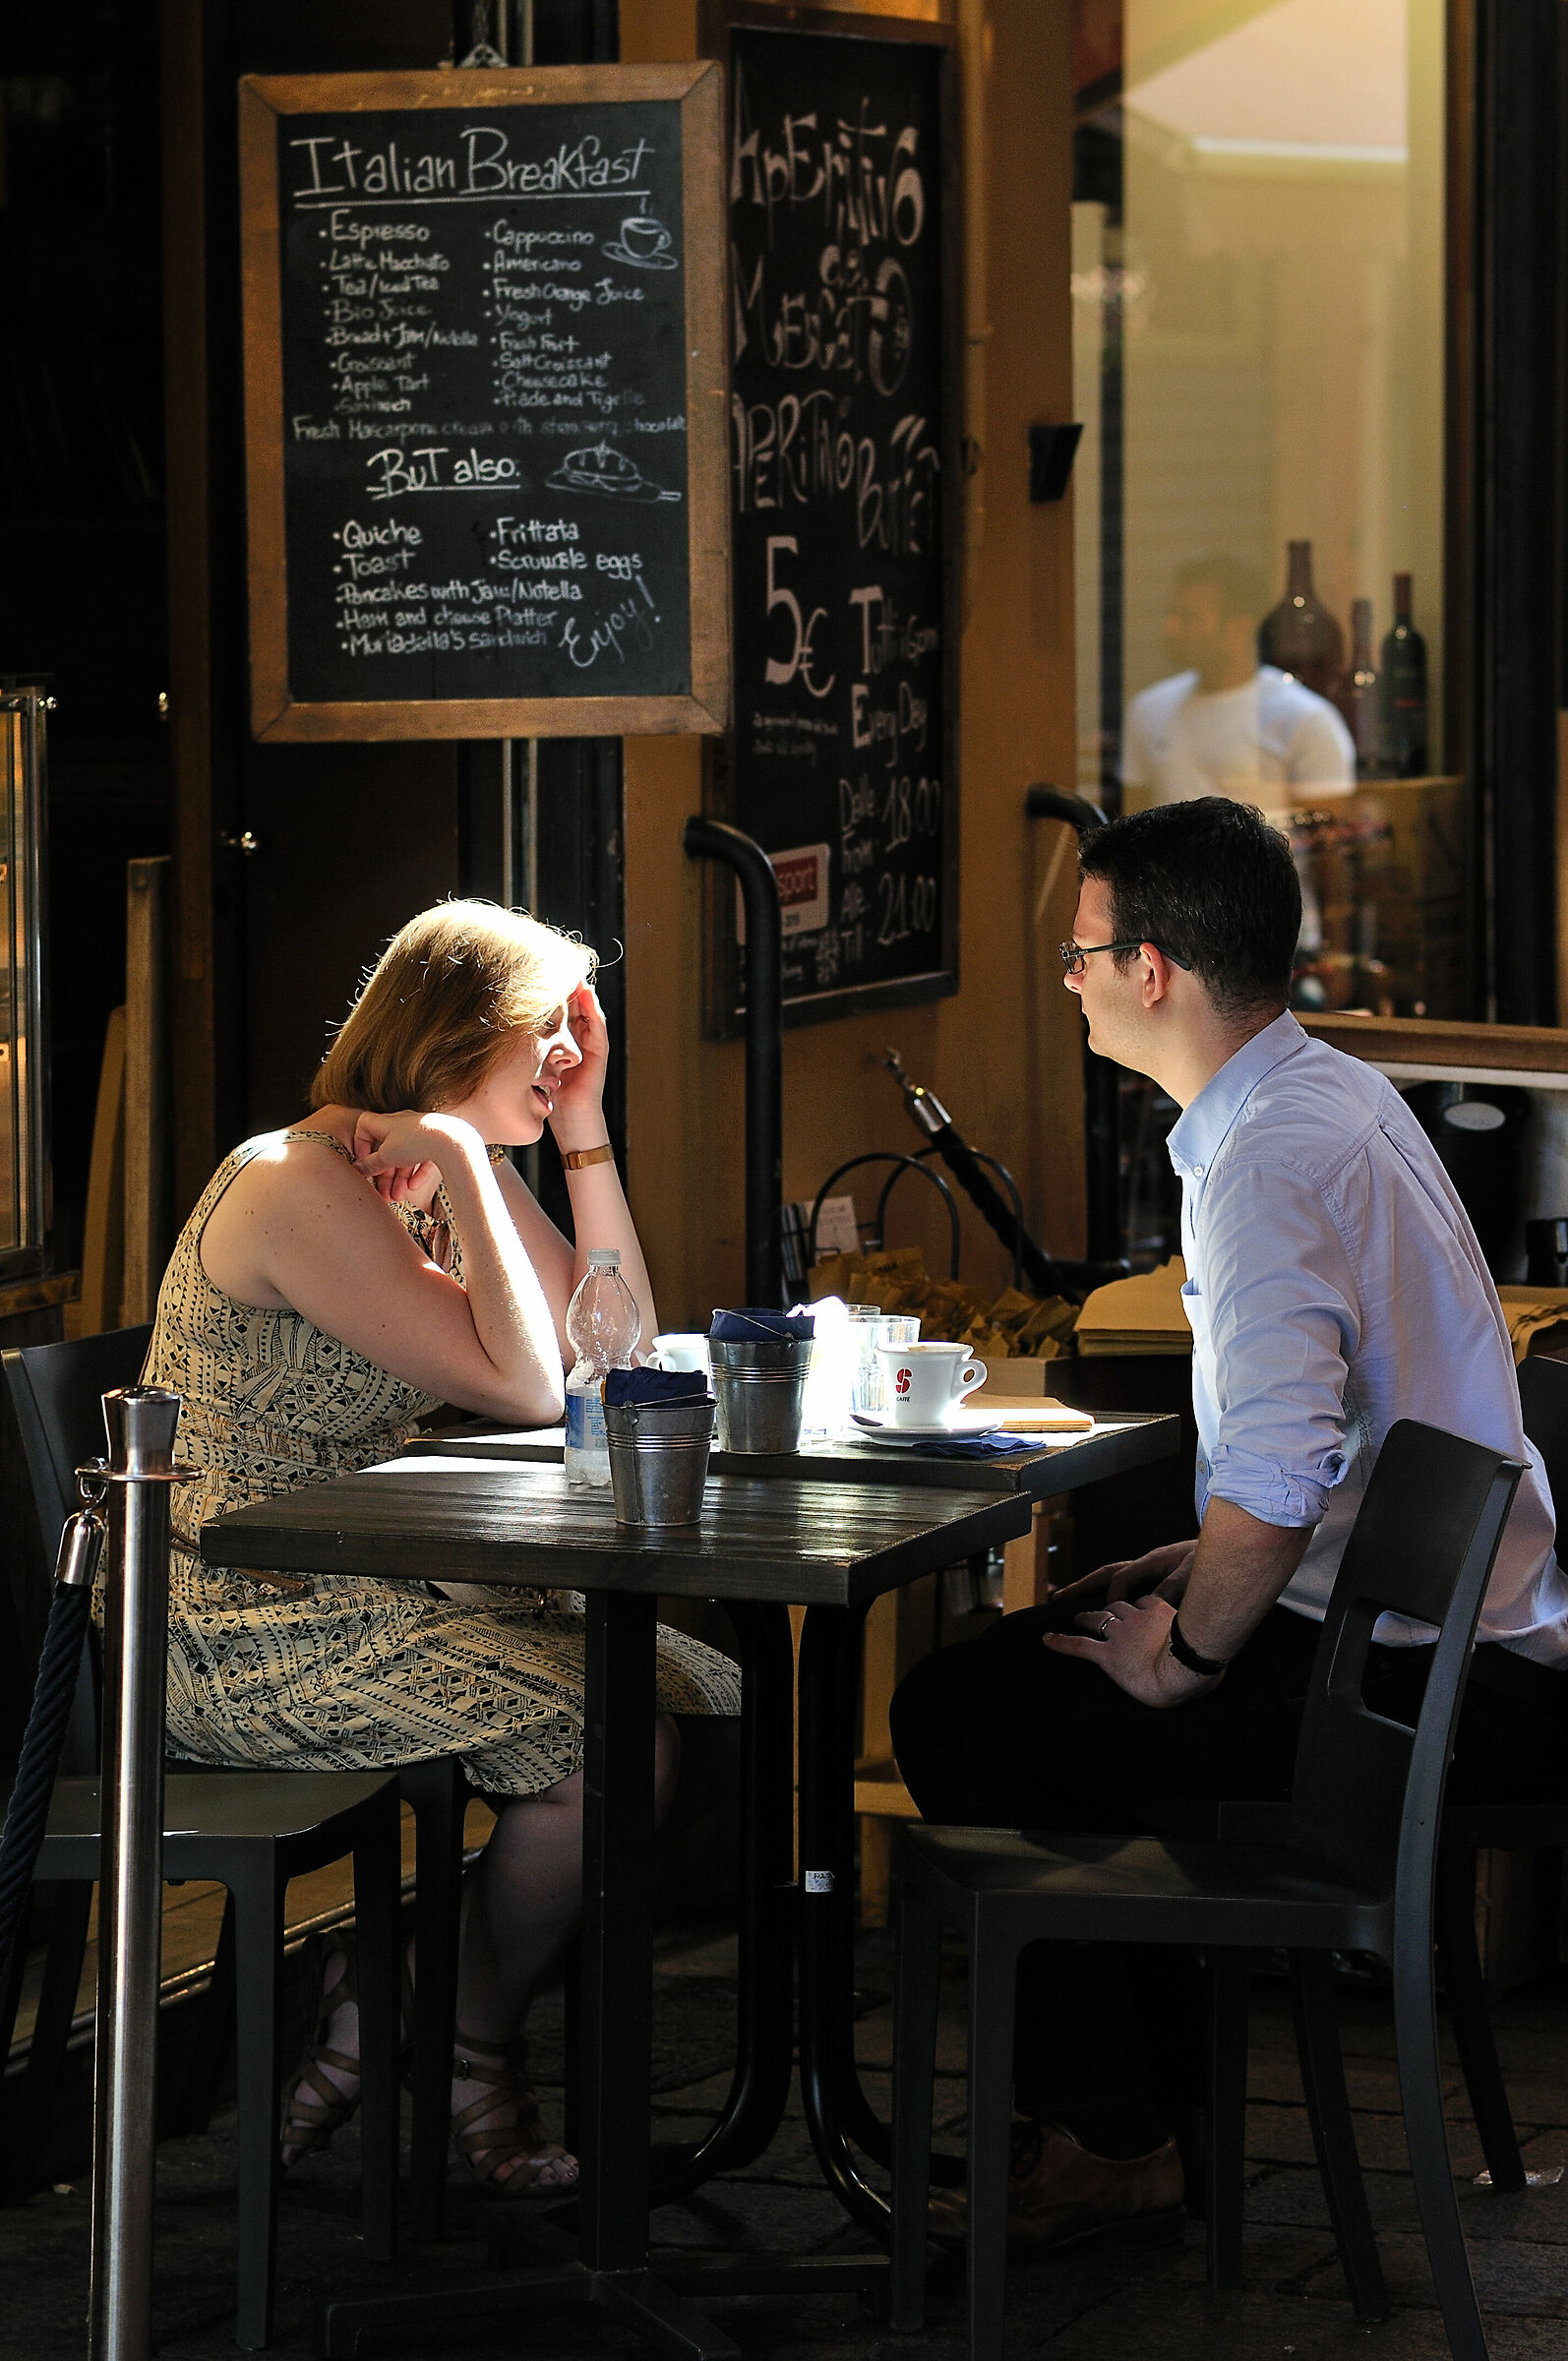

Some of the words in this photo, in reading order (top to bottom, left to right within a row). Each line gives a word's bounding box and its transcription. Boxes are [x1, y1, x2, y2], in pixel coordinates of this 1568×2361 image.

[290, 136, 456, 197] Italian
[457, 127, 656, 196] Breakfast
[331, 209, 431, 250] Espresso
[493, 218, 595, 253] Cappuccino
[493, 249, 582, 273] Americano
[493, 276, 541, 300] Fresh
[594, 276, 645, 306] Juice
[329, 297, 375, 324] Bio
[339, 374, 390, 400] Apple
[292, 414, 341, 440] Fresh
[342, 517, 424, 549] Quiche
[496, 516, 580, 546] Frittata
[341, 547, 417, 580] Toast
[595, 553, 643, 581] eggs
[343, 608, 390, 631] Ham
[394, 605, 428, 628] and
